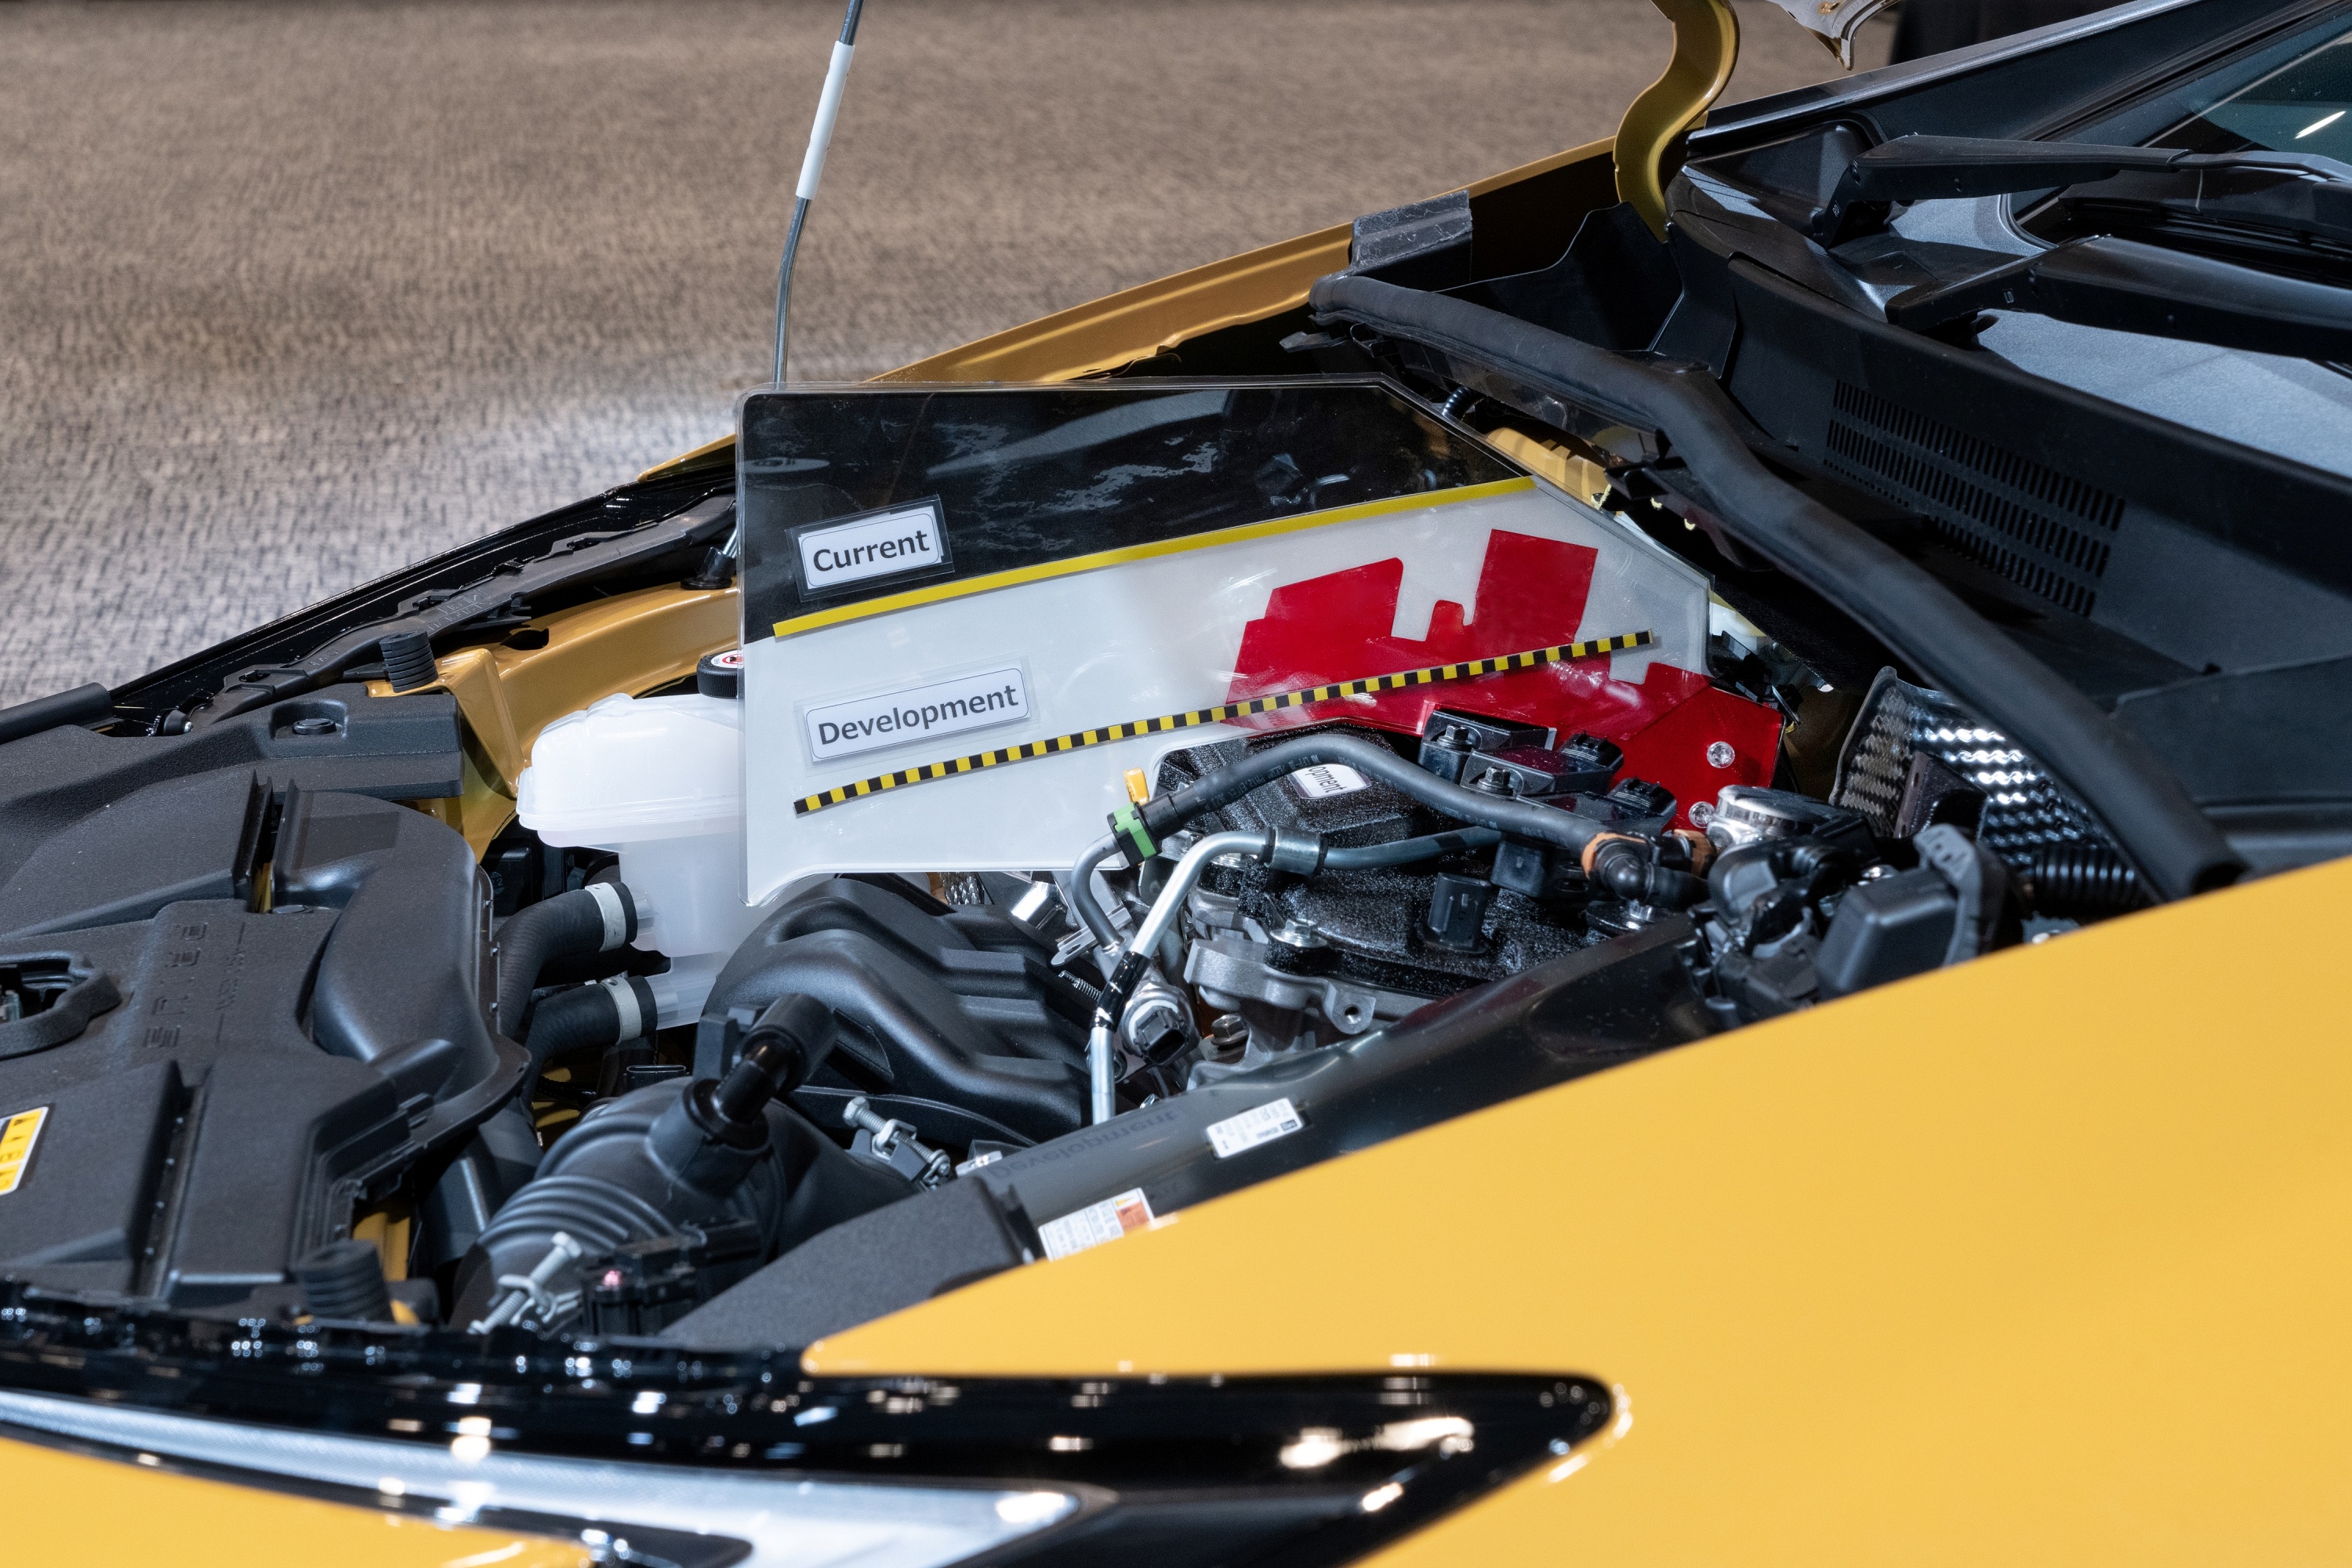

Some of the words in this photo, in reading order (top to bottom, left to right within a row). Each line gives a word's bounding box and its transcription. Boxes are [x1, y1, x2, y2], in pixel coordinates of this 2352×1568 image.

[814, 530, 930, 572] Current
[818, 685, 1018, 745] Development
[1305, 766, 1348, 793] opment
